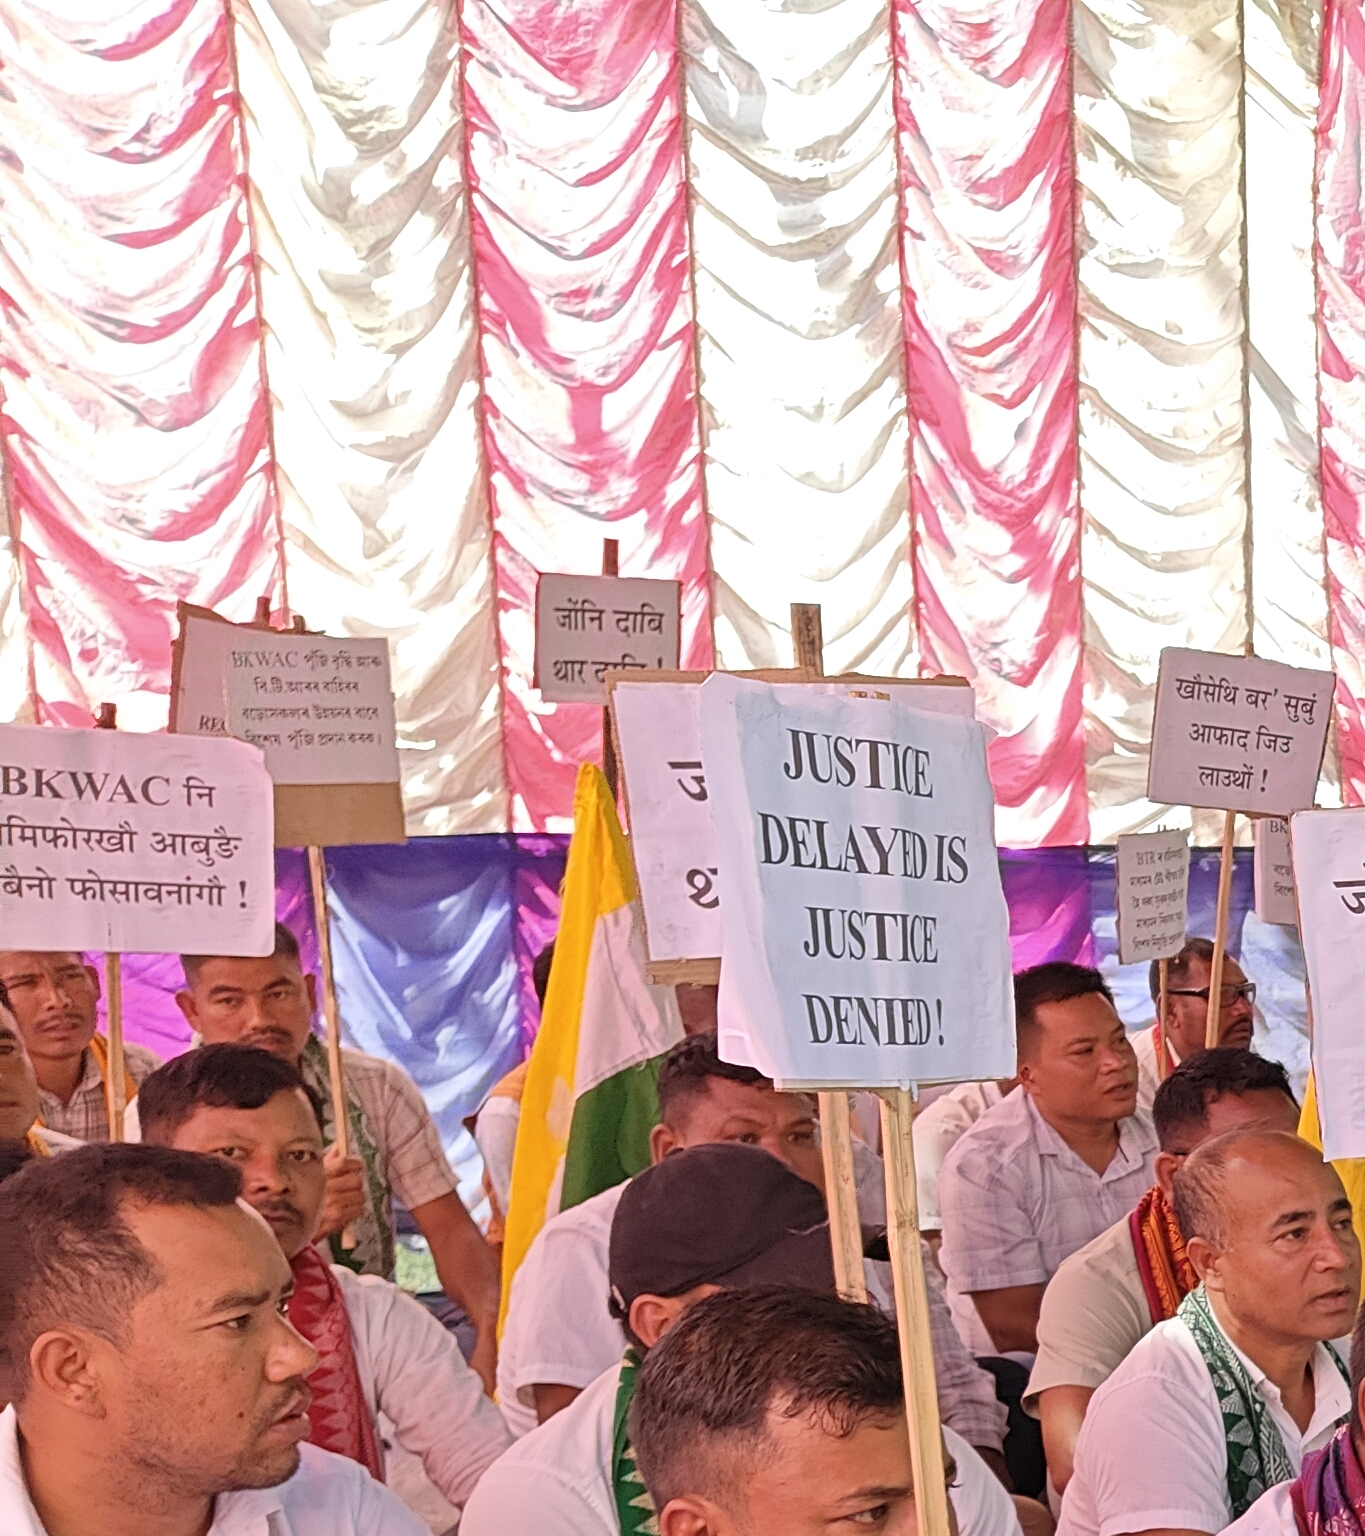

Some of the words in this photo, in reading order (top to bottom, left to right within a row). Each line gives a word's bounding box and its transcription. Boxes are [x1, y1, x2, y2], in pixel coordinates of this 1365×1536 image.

[554, 597, 606, 634] जोंनि
[613, 602, 665, 637] दाबि
[231, 650, 299, 669] BKWAC
[1283, 692, 1318, 725] सुबुं
[1189, 722, 1250, 752] आफाद
[1256, 725, 1294, 754] जिउ
[784, 728, 934, 799] JUSTICE
[1198, 763, 1254, 790] लाउथों
[1, 765, 171, 806] BKWAC
[183, 776, 216, 808] नि
[0, 815, 138, 854] मिफोरखौ
[757, 811, 928, 880] DELAYED
[933, 834, 969, 884] IS
[0, 865, 57, 900] बैनो
[803, 906, 939, 964] JUSTICE
